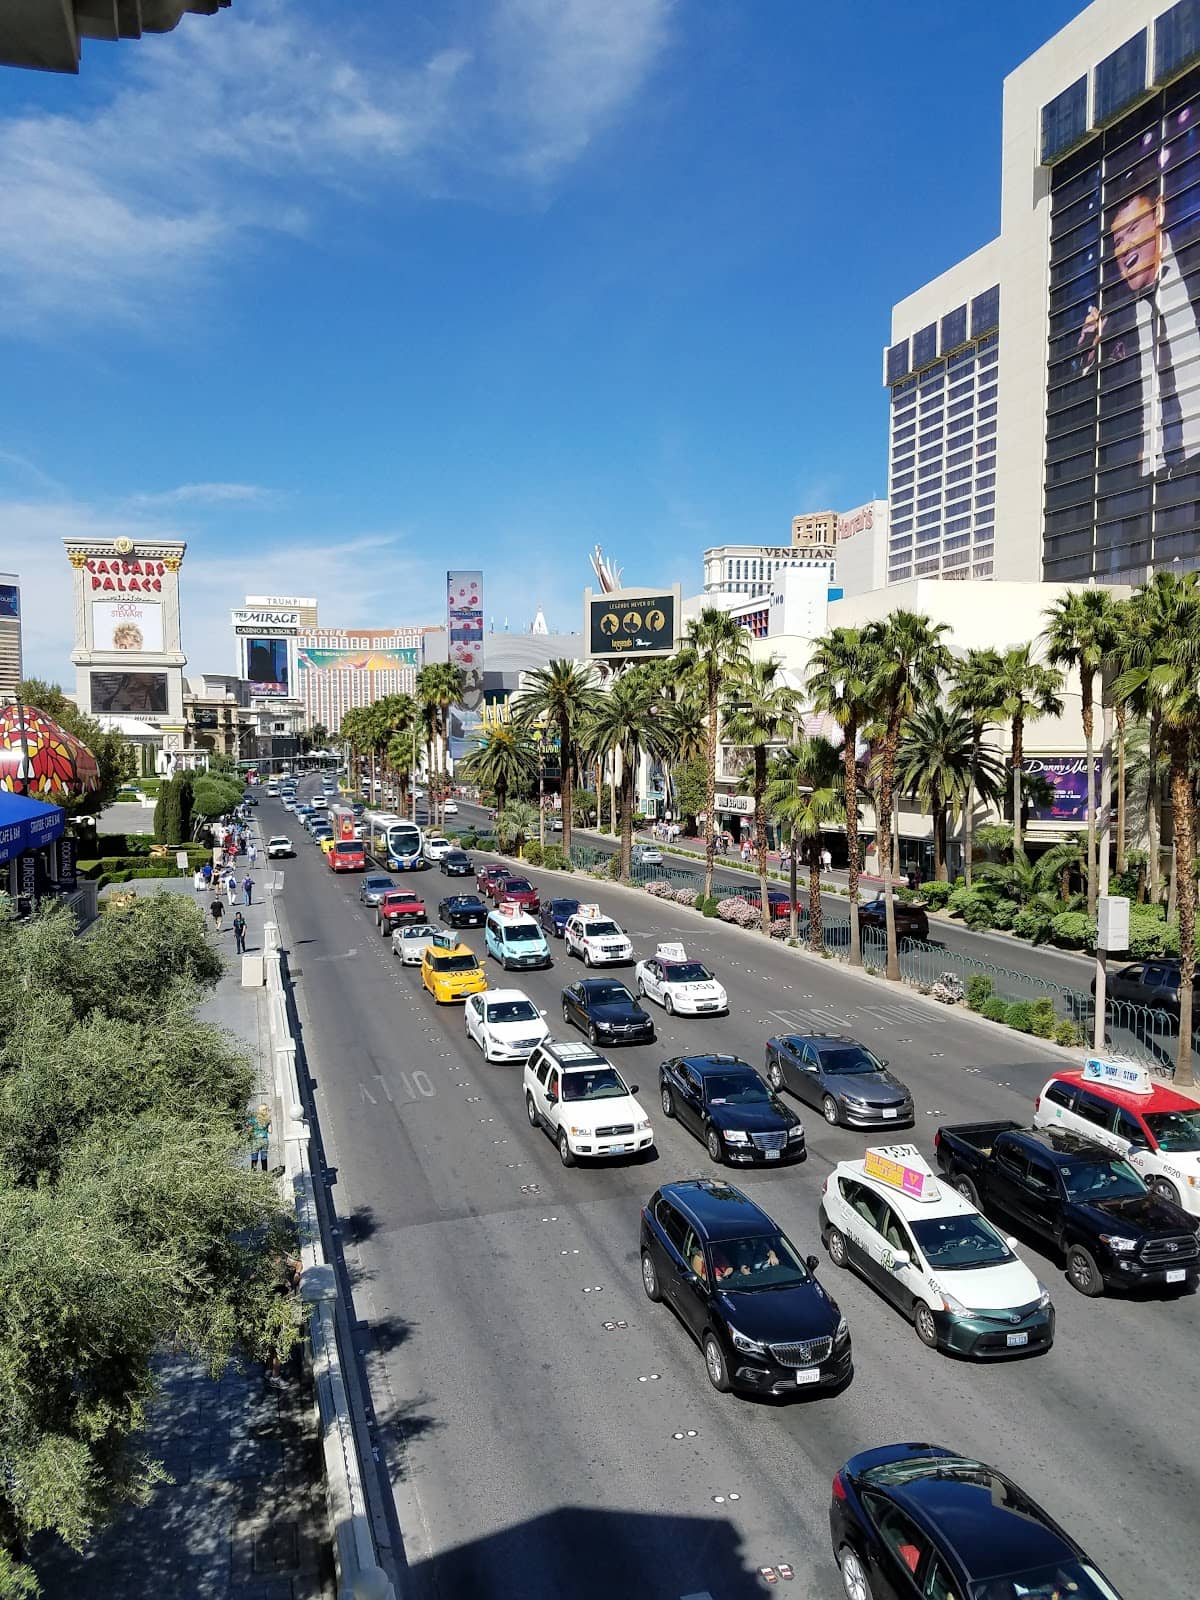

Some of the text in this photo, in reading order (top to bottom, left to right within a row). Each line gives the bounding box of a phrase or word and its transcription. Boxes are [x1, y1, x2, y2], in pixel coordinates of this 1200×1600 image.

[838, 505, 873, 539] Harrah's
[765, 548, 833, 558] VENETIAN
[88, 560, 165, 576] CAESARS
[92, 577, 162, 592] PALACE
[118, 604, 137, 612] ROD
[267, 598, 299, 606] TRUMP
[111, 610, 143, 618] STEWART
[244, 613, 298, 624] MIRAGE
[1023, 759, 1066, 774] Donny
[62, 841, 72, 877] COCKTAILS
[681, 983, 715, 992] 7350
[1128, 1154, 1145, 1167] CAB
[1162, 1164, 1182, 1179] 6520
